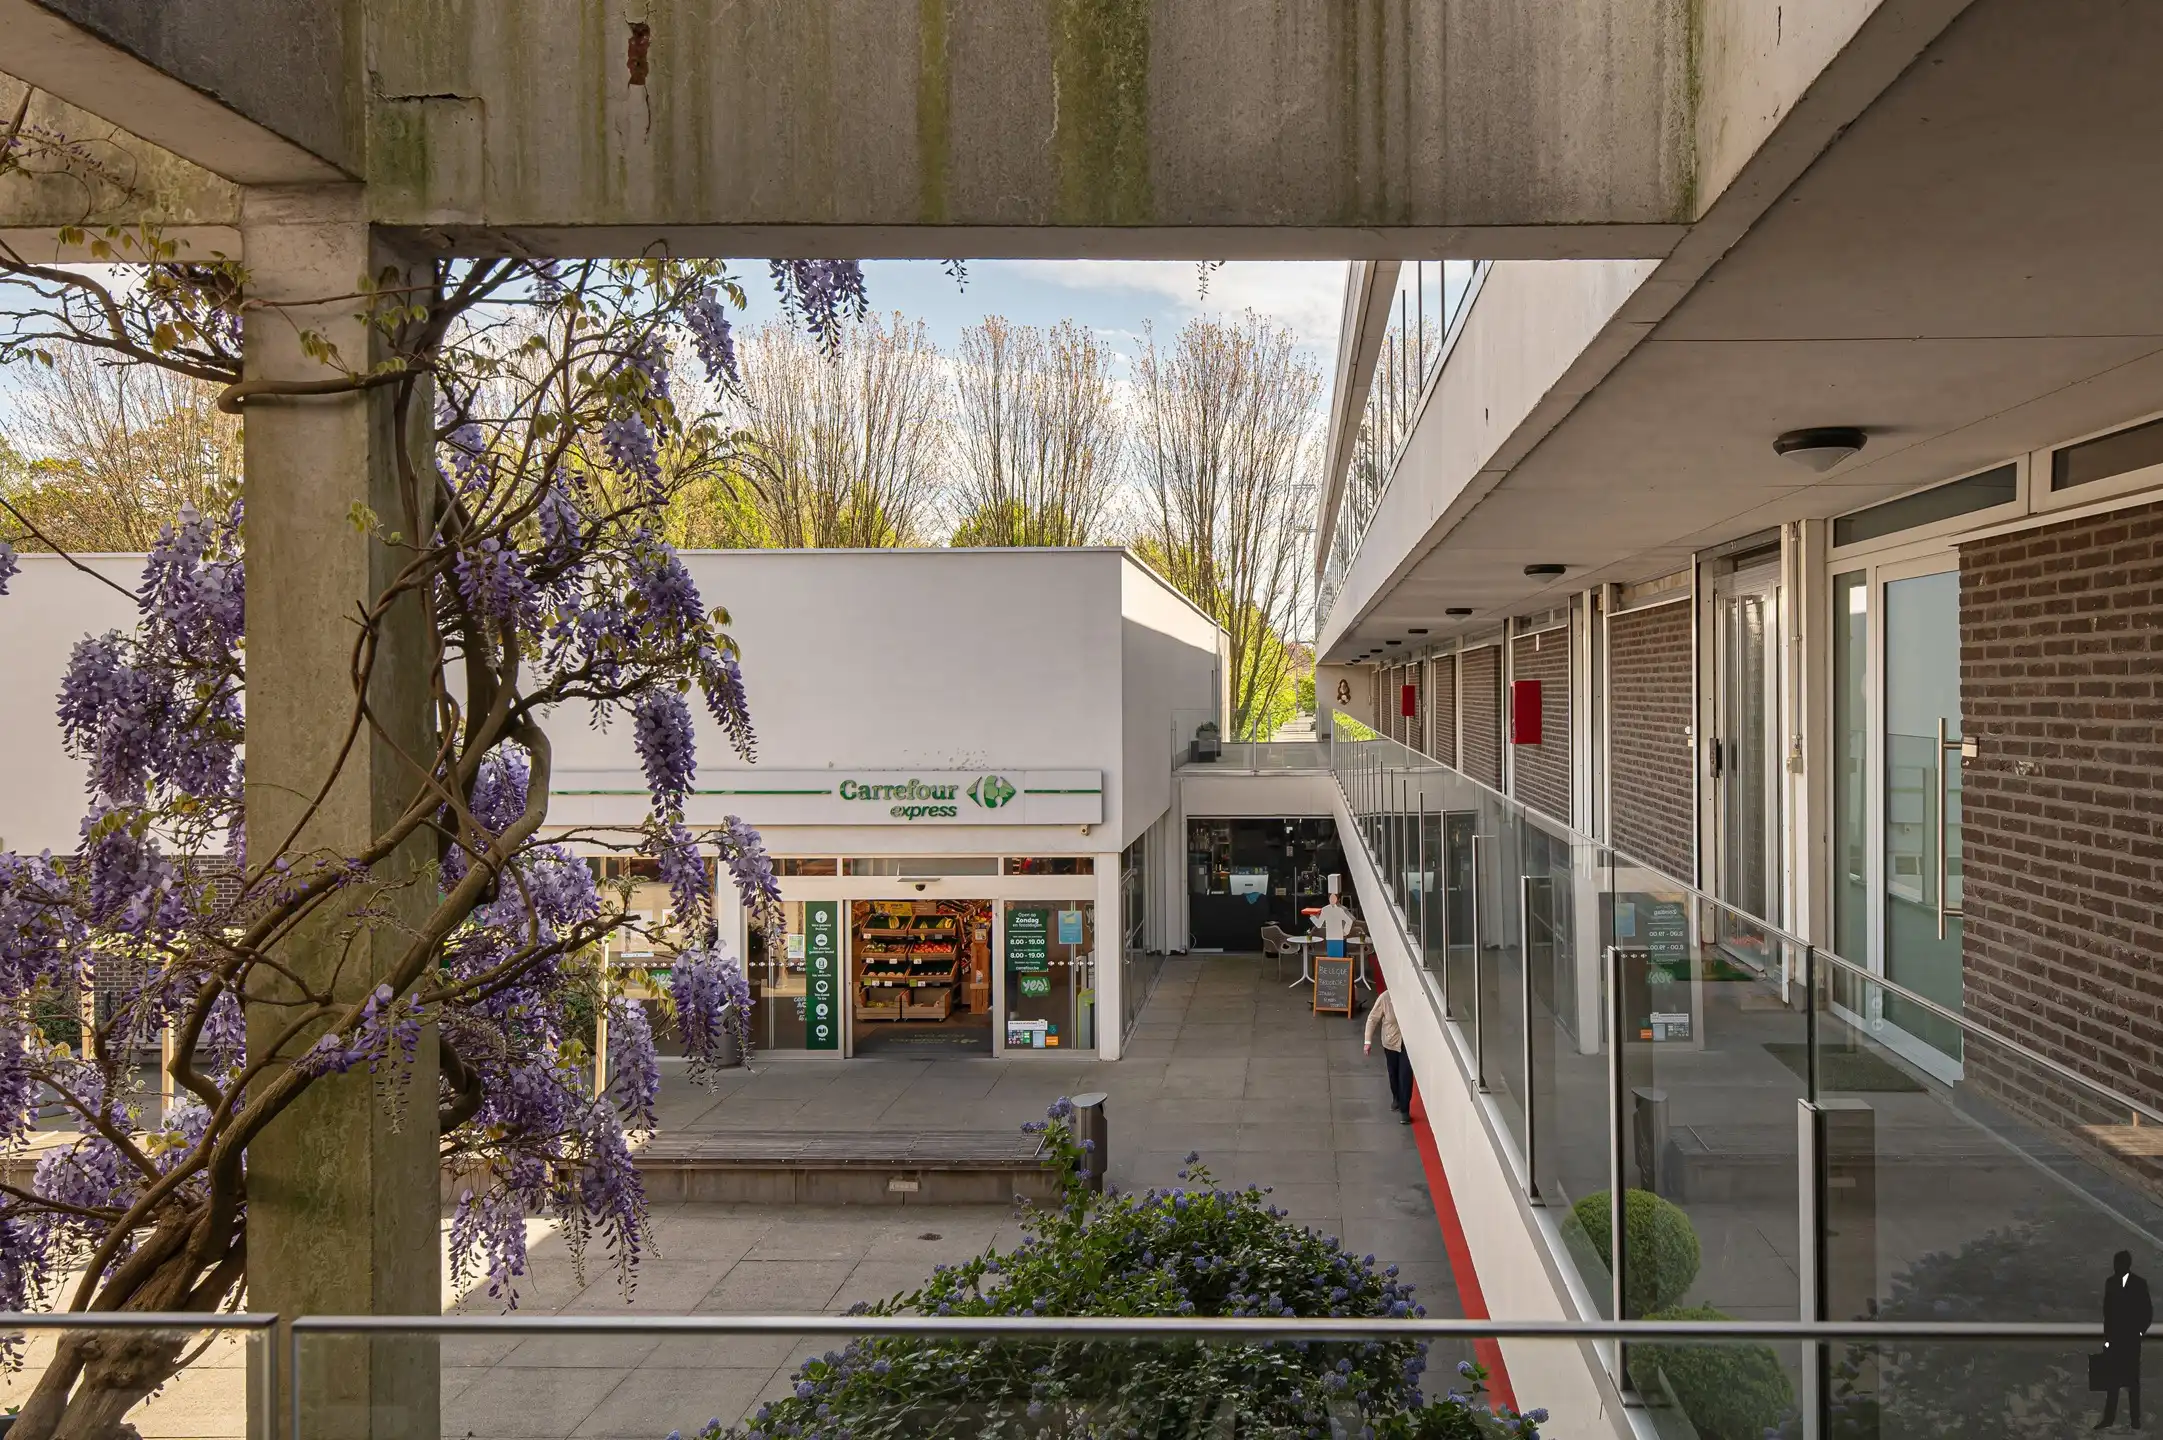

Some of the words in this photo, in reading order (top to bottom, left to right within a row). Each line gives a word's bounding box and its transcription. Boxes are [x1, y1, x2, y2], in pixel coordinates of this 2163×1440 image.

[839, 778, 959, 800] Carrefour
[890, 805, 957, 820] express
[1022, 978, 1049, 992] yes!
